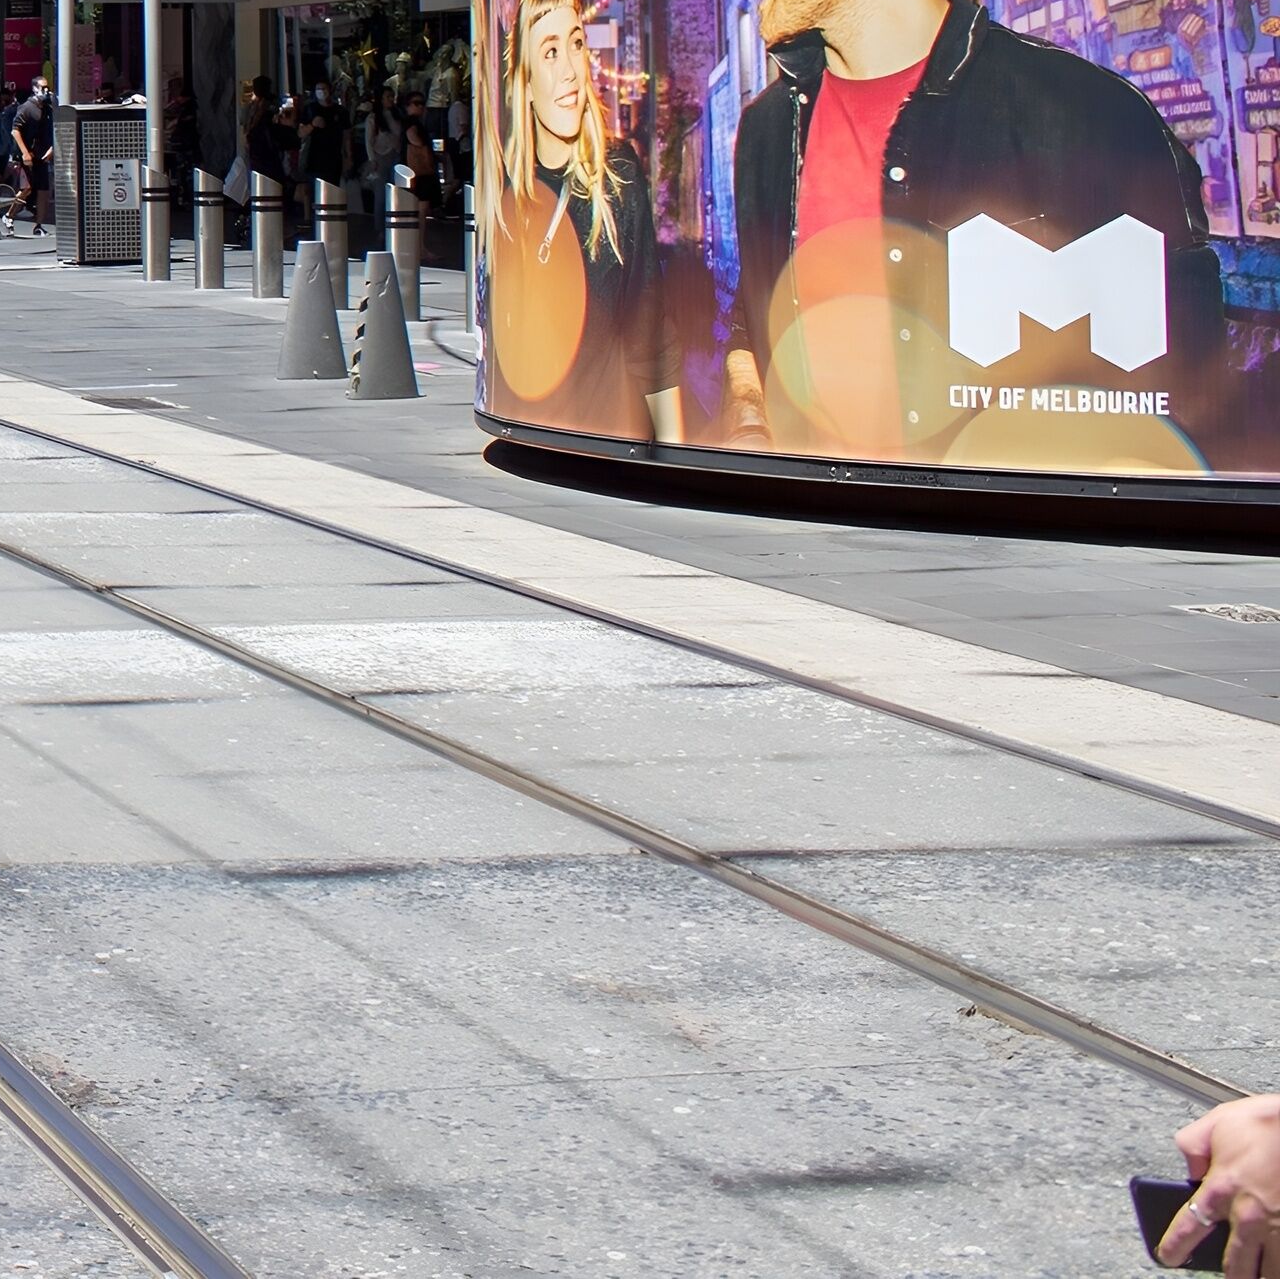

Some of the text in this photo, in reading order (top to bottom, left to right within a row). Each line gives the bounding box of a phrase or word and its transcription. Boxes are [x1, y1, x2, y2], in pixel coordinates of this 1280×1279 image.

[949, 385, 1170, 416] CITY OF MELBOURNE
